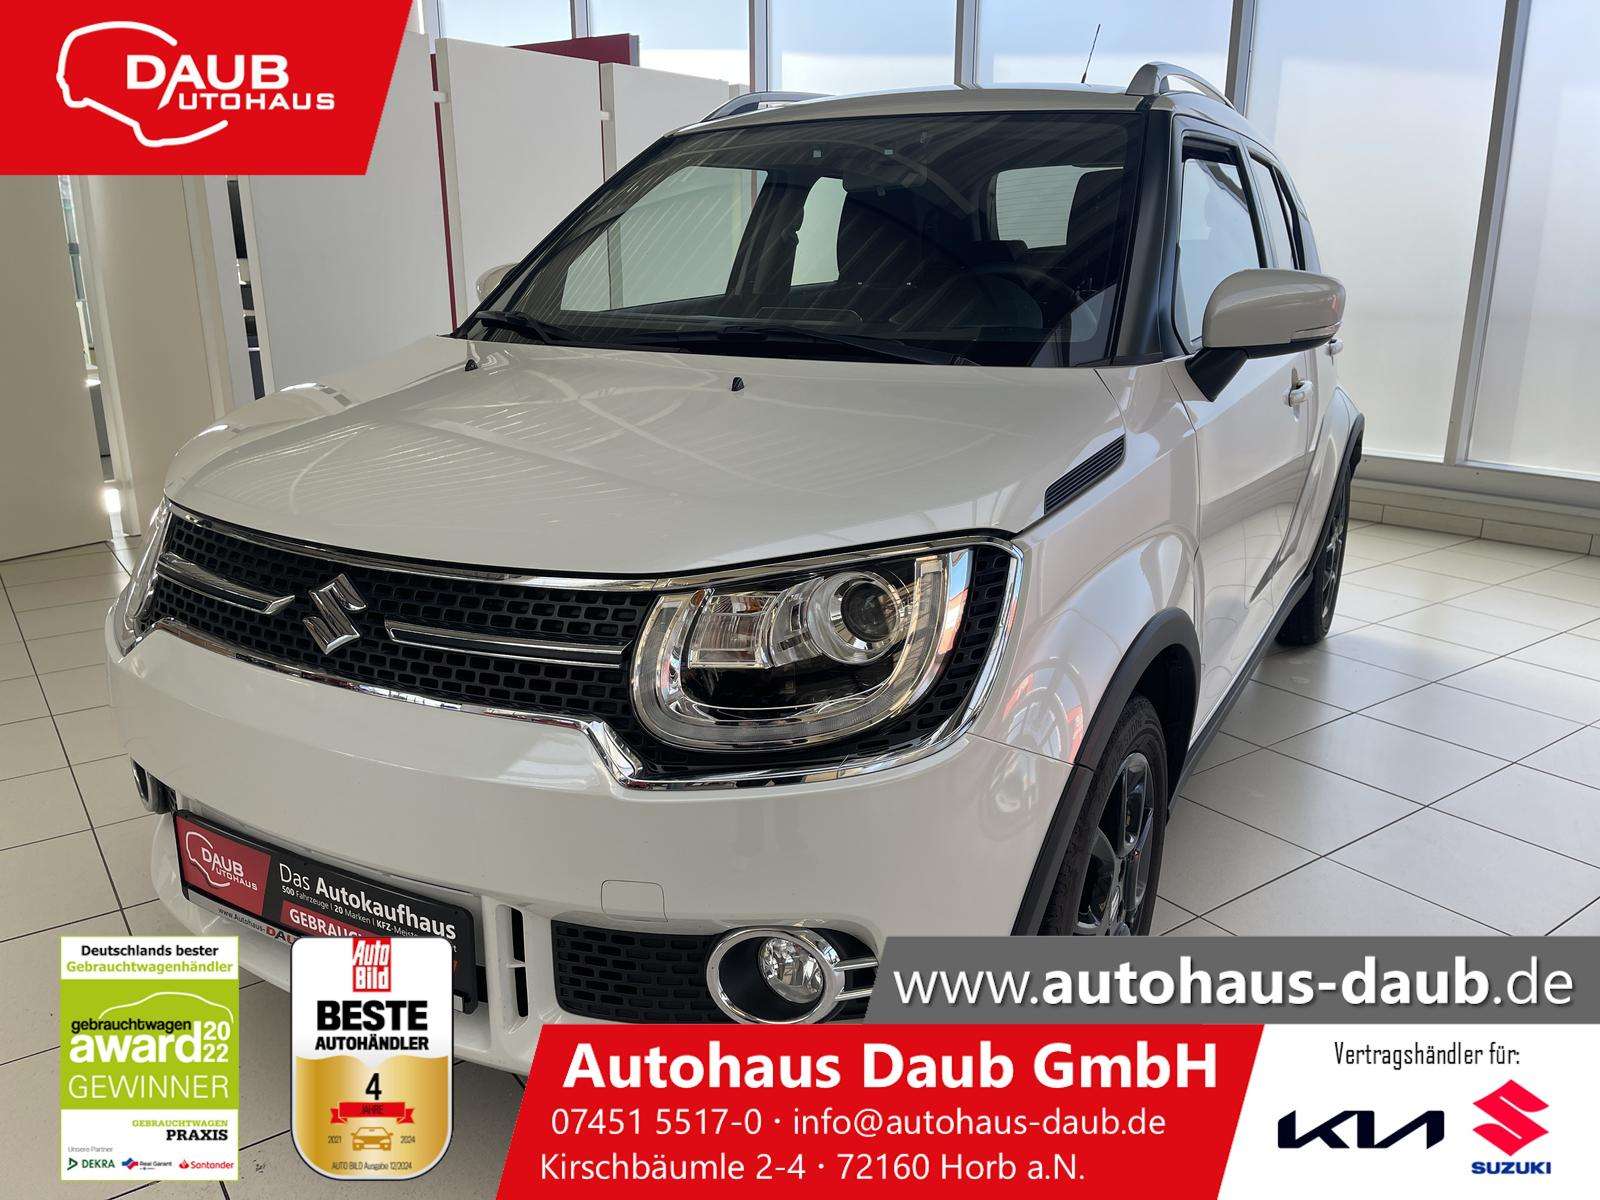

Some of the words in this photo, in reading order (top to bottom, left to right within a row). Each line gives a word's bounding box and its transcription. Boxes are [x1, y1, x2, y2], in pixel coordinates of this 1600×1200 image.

[201, 847, 245, 877] DAUB
[279, 862, 311, 891] Das
[315, 876, 457, 940] Autokaufhaus
[281, 885, 295, 896] 500
[295, 890, 330, 911] Fahrzeuge
[334, 904, 344, 915] 20
[345, 908, 372, 925] Marken
